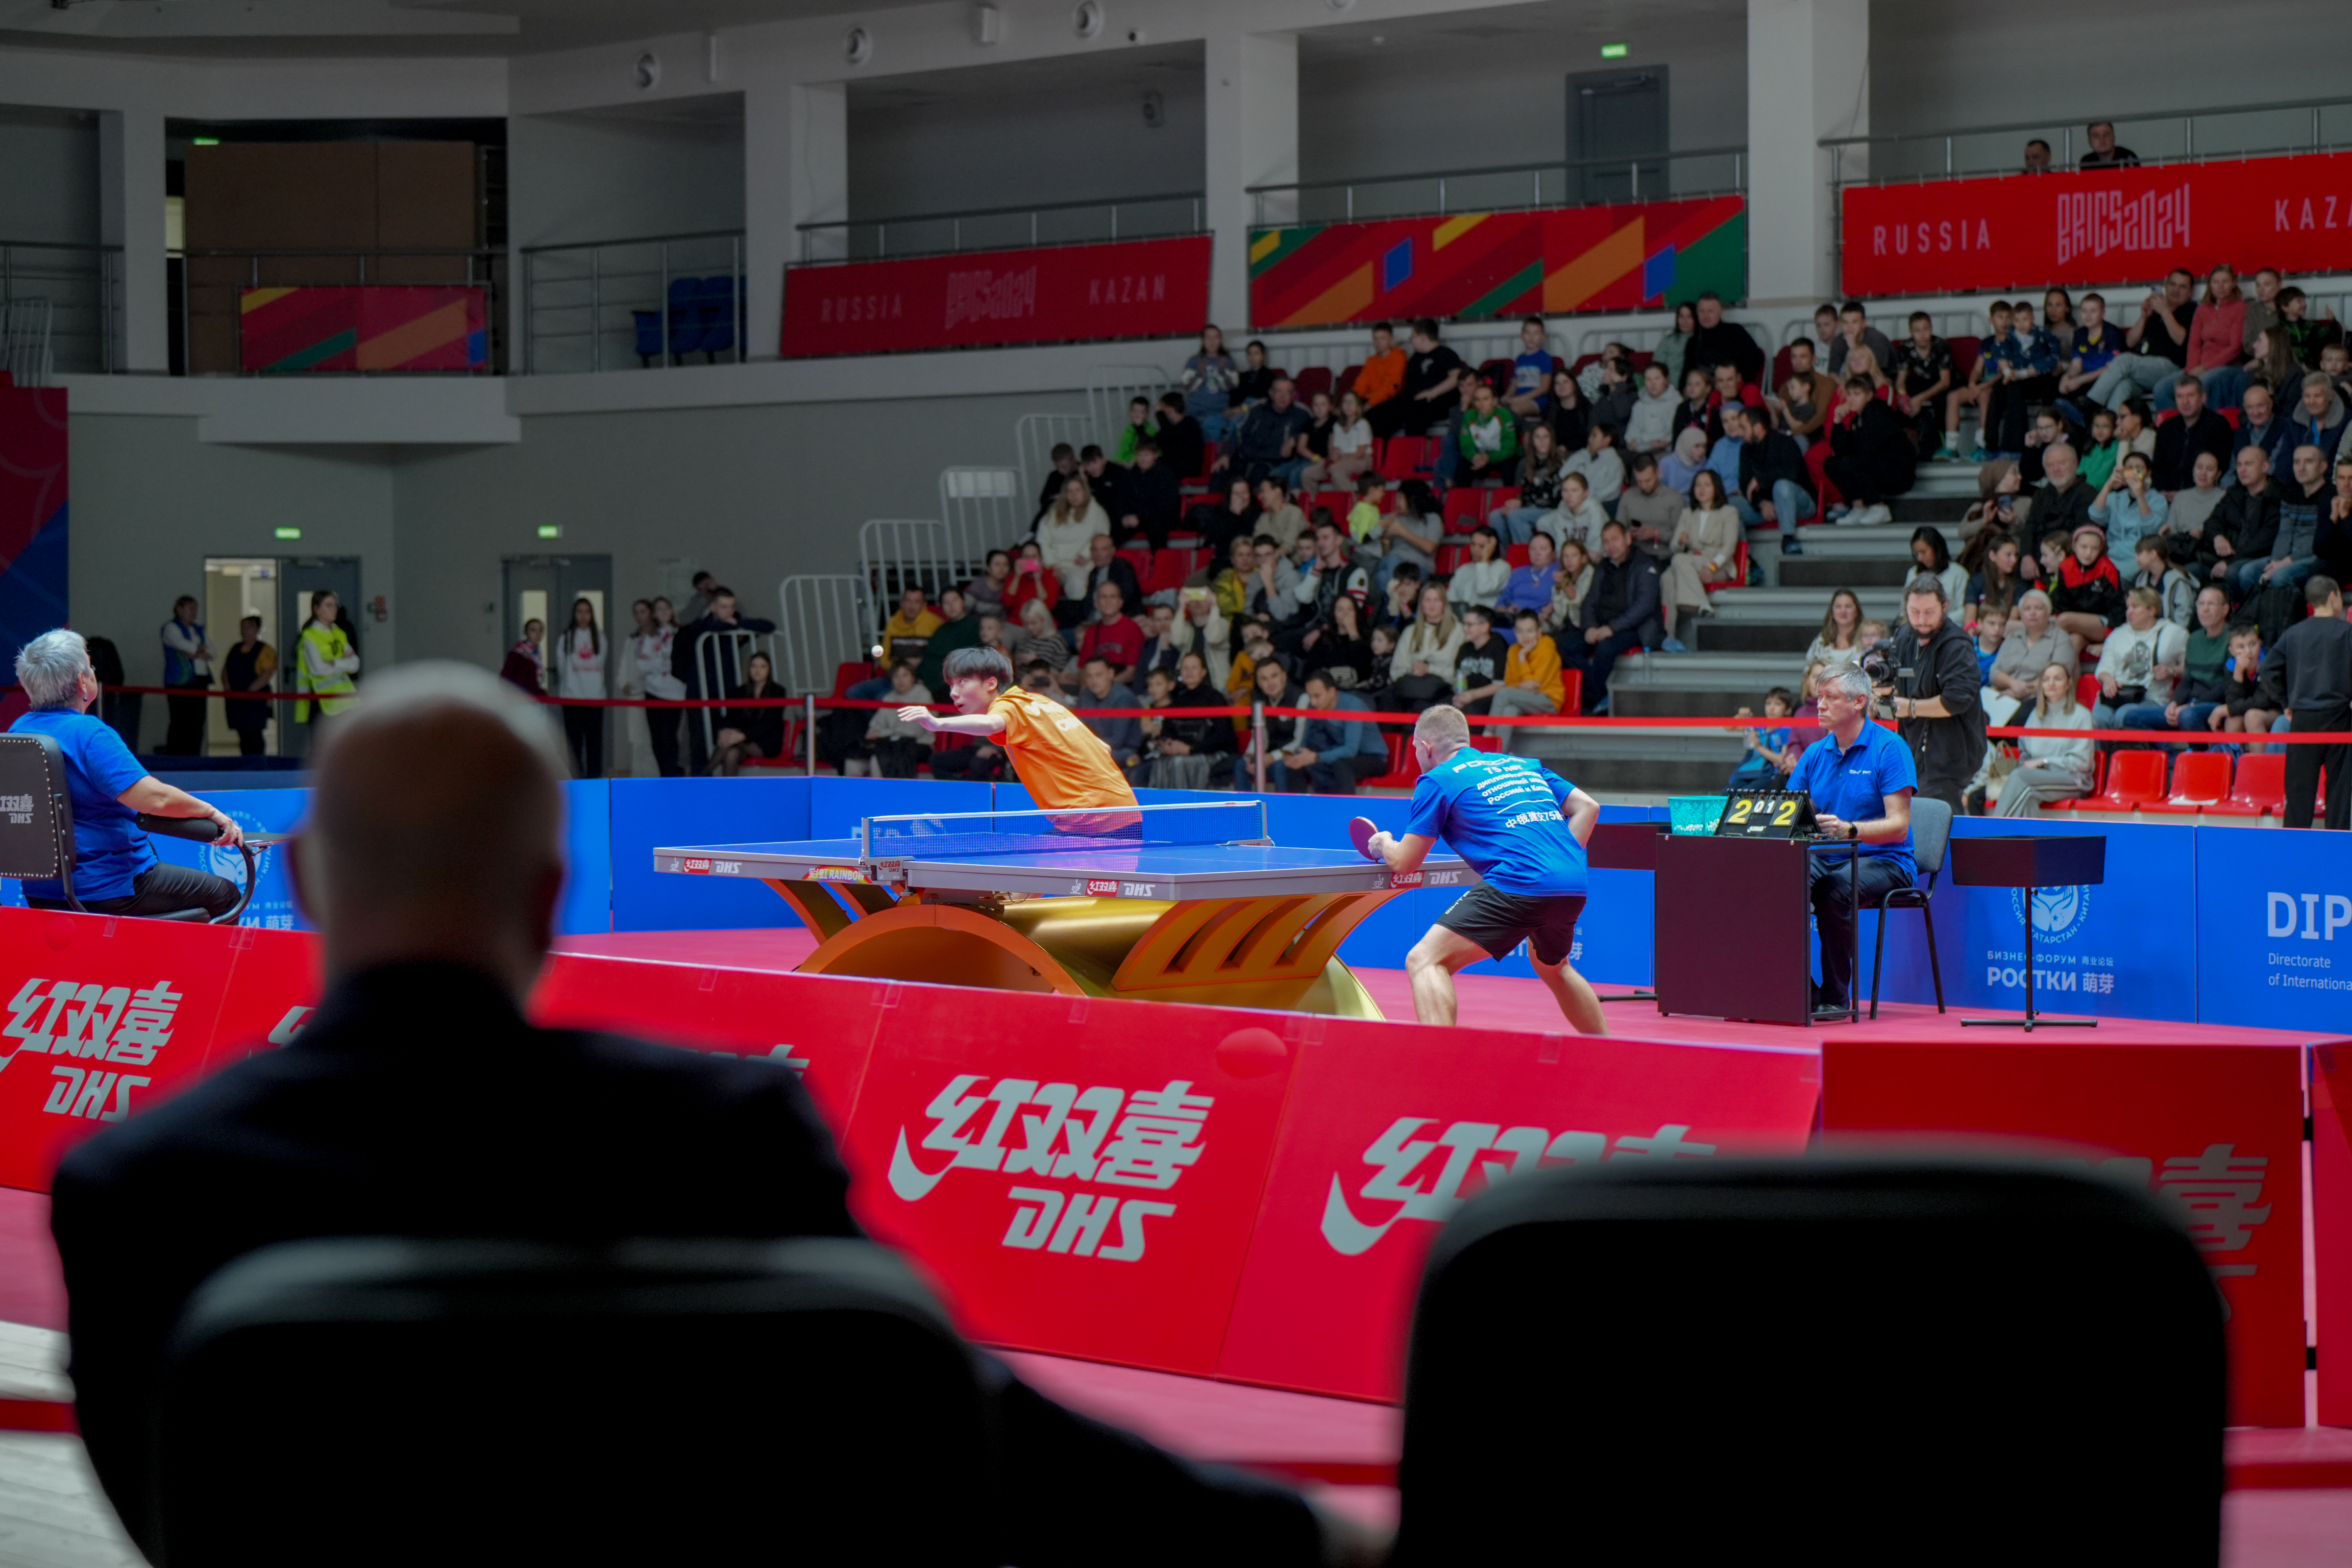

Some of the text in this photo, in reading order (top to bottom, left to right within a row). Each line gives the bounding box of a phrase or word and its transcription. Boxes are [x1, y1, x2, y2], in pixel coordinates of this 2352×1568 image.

[1874, 218, 1991, 256] RUSSIA
[1089, 274, 1166, 306] KAZAN
[820, 292, 903, 323] RUSSIA
[1483, 766, 1502, 774] 75
[1482, 777, 1529, 797] отношений
[1487, 786, 1525, 804] Россией
[9, 813, 34, 823] DHS
[1728, 799, 1796, 825] 2 0 1 2
[684, 859, 709, 872] 红双喜
[715, 861, 742, 874] DHS
[808, 868, 865, 881] 彩虹 RAINBOW
[1390, 872, 1423, 888] 红双喜
[1429, 871, 1462, 885] DHS
[1087, 881, 1117, 895] 红双喜
[1123, 883, 1156, 897] DHS
[2011, 887, 2026, 926] ОССИЯ
[2078, 885, 2090, 922] КИТАЙ
[2268, 892, 2352, 940] DIP
[1988, 950, 2076, 964] БИЗНЕ-ФОРУМ
[2082, 955, 2113, 967] 商业论坛
[2269, 953, 2331, 968] Directorate
[2082, 972, 2114, 994] 萌芽
[2269, 973, 2280, 986] of
[43, 1065, 152, 1123] DHS
[888, 1074, 1214, 1202] 红双喜
[1001, 1186, 1177, 1262] DHS
